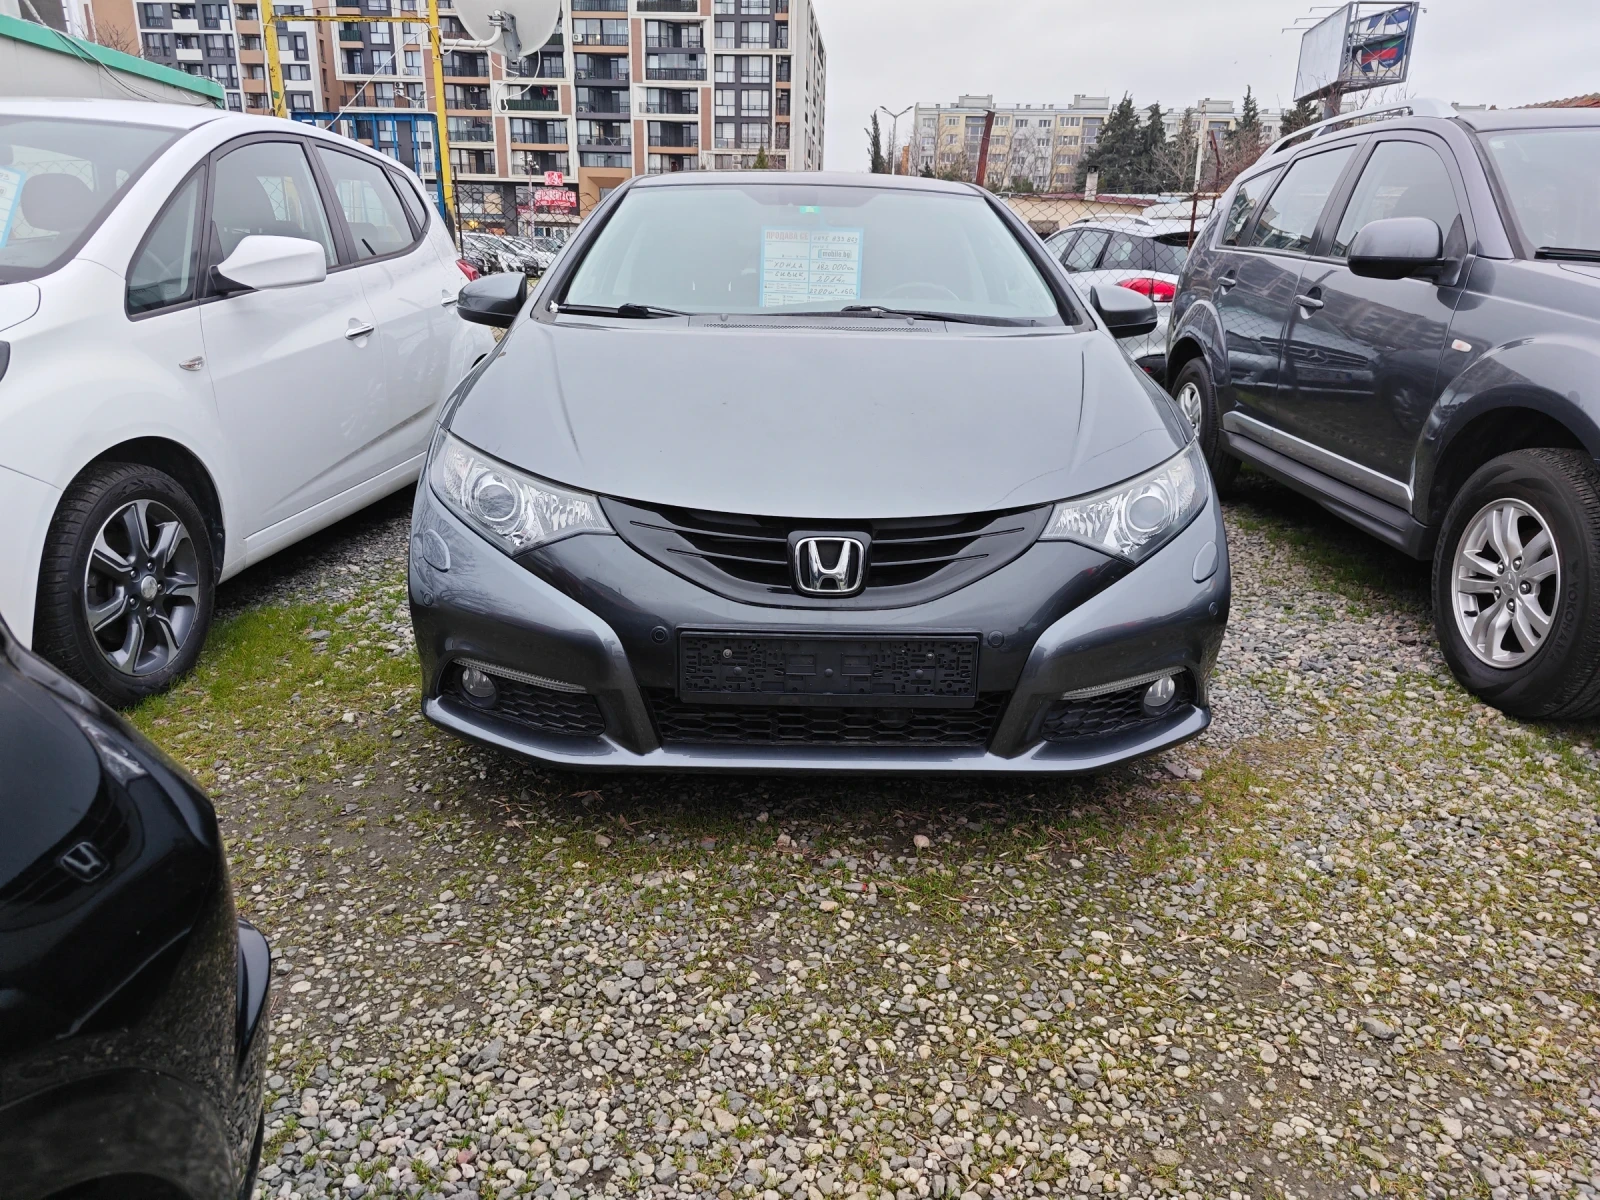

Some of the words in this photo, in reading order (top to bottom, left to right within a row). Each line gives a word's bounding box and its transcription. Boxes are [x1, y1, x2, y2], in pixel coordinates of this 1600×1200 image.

[766, 231, 798, 240] ПРОДАВА
[822, 250, 851, 259] mobile.bg
[1549, 581, 1579, 662] YOKOHAMA
